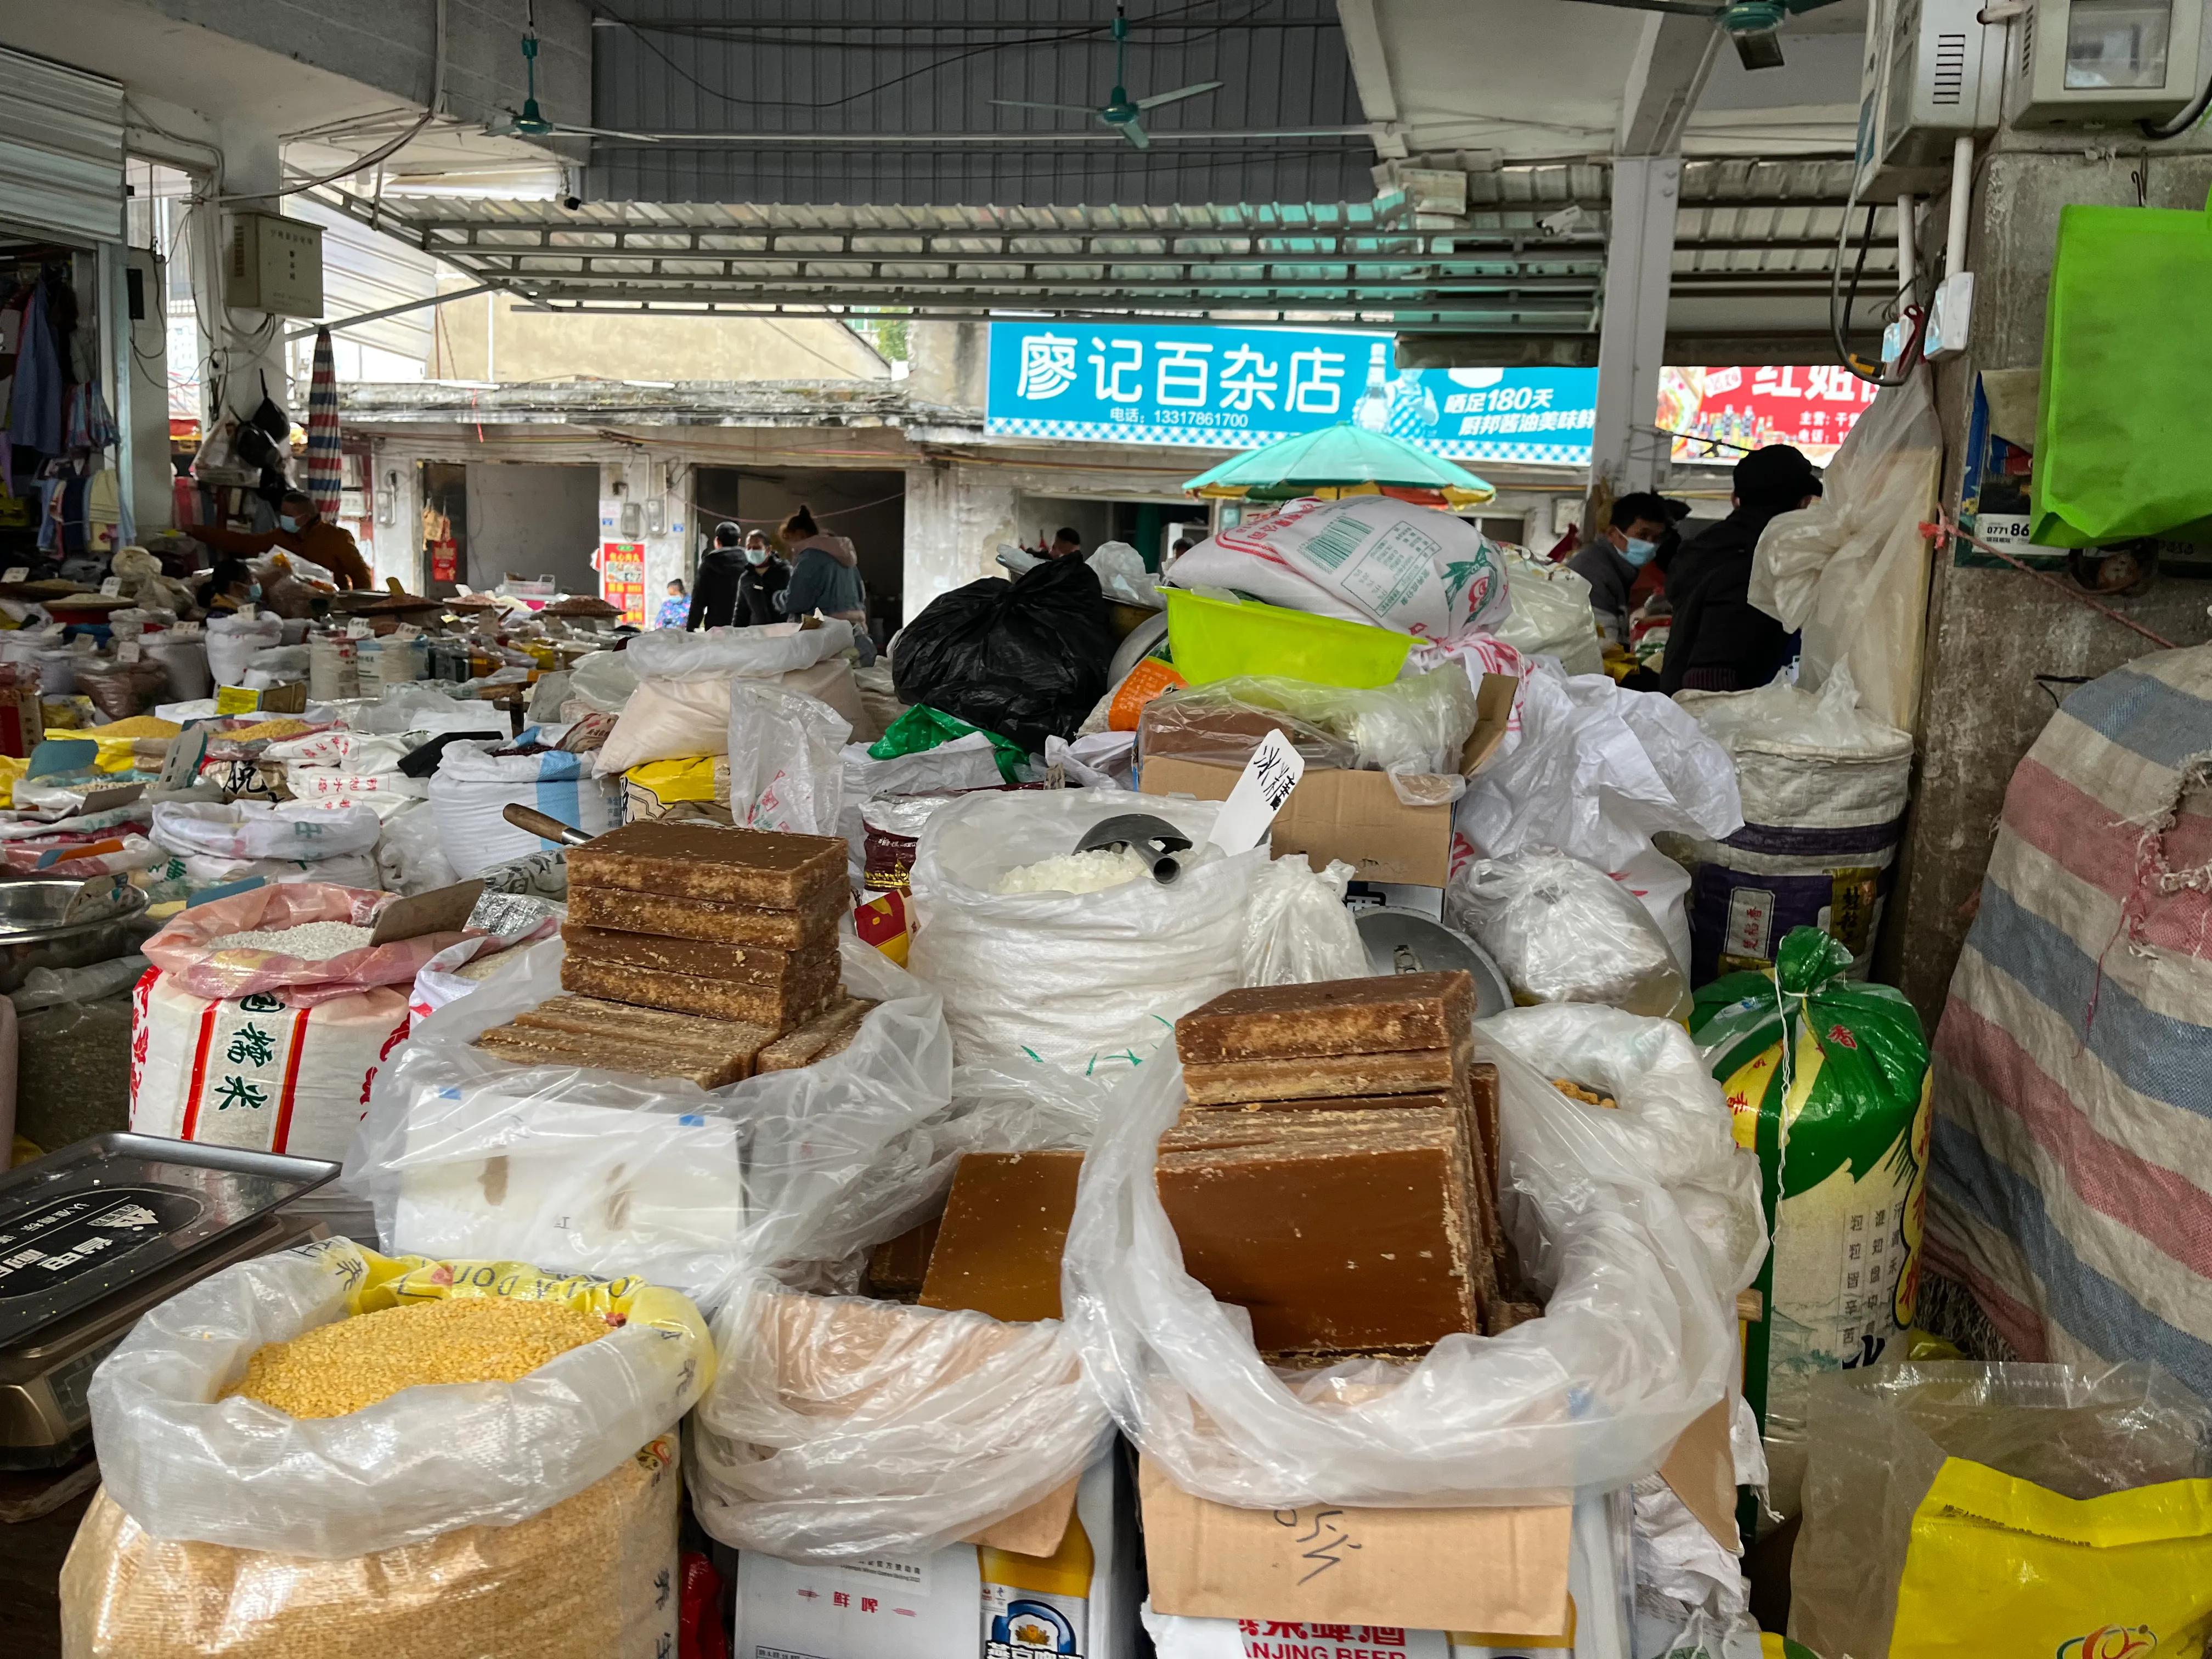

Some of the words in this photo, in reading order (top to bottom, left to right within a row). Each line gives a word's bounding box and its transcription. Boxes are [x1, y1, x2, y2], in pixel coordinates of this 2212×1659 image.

[1017, 331, 1346, 415] 廖记百杂店
[1752, 366, 1880, 402] 红姐
[1444, 386, 1554, 414] 晒足180天
[1154, 410, 1248, 427] 13317861700
[1987, 526, 2008, 534] 0771
[833, 1590, 878, 1613] 鲜啤
